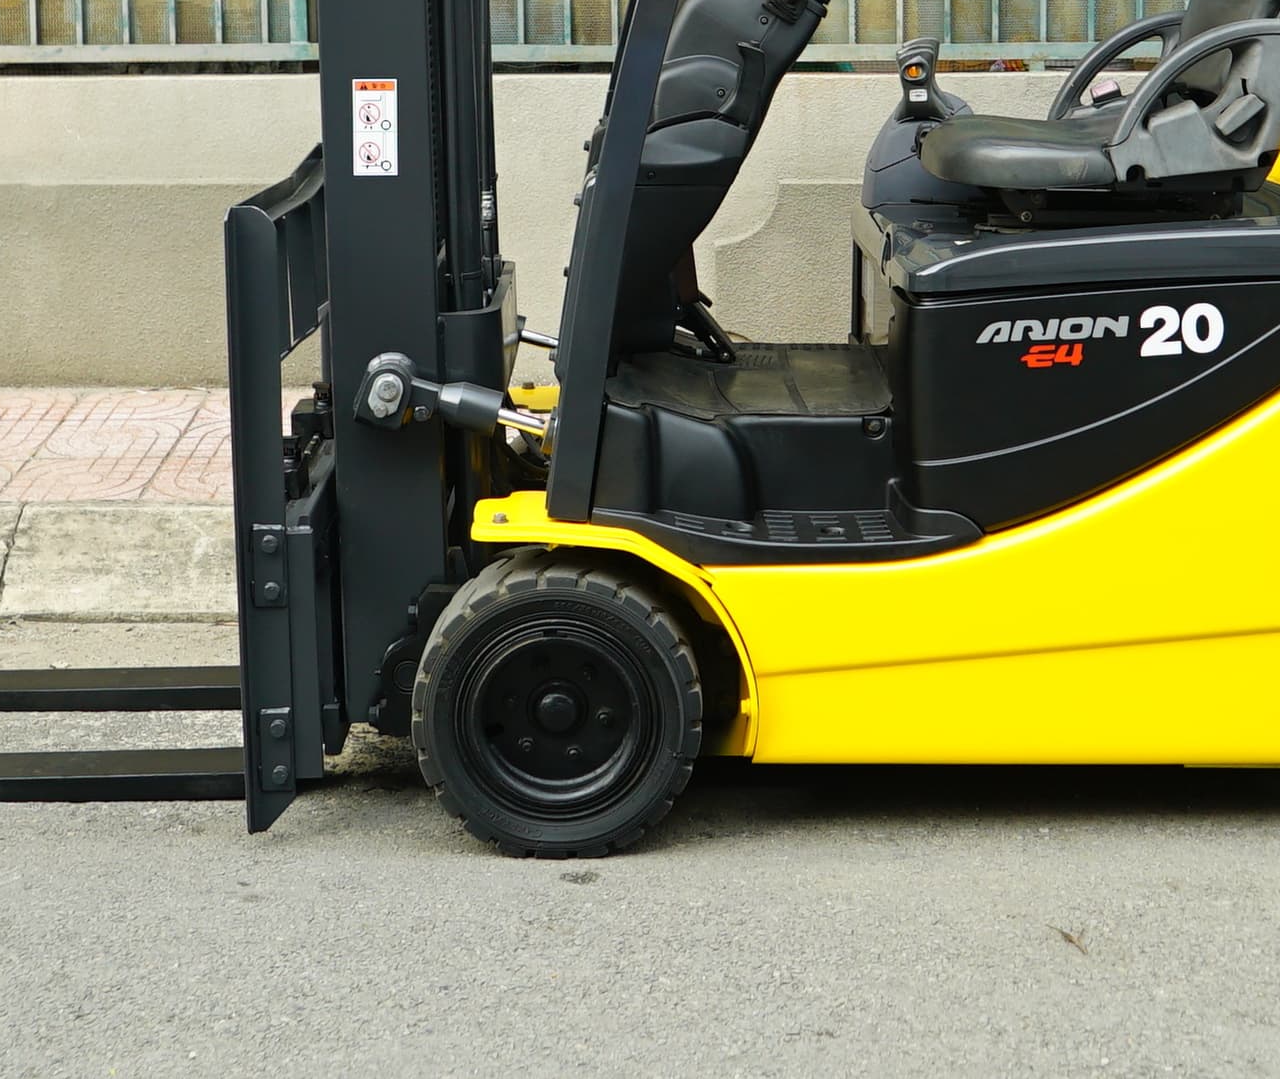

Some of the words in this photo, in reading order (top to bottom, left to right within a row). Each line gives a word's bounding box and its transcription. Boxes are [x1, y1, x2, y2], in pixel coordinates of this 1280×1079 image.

[975, 315, 1129, 345] ARION
[1139, 302, 1225, 357] 20
[1020, 343, 1084, 368] E4
